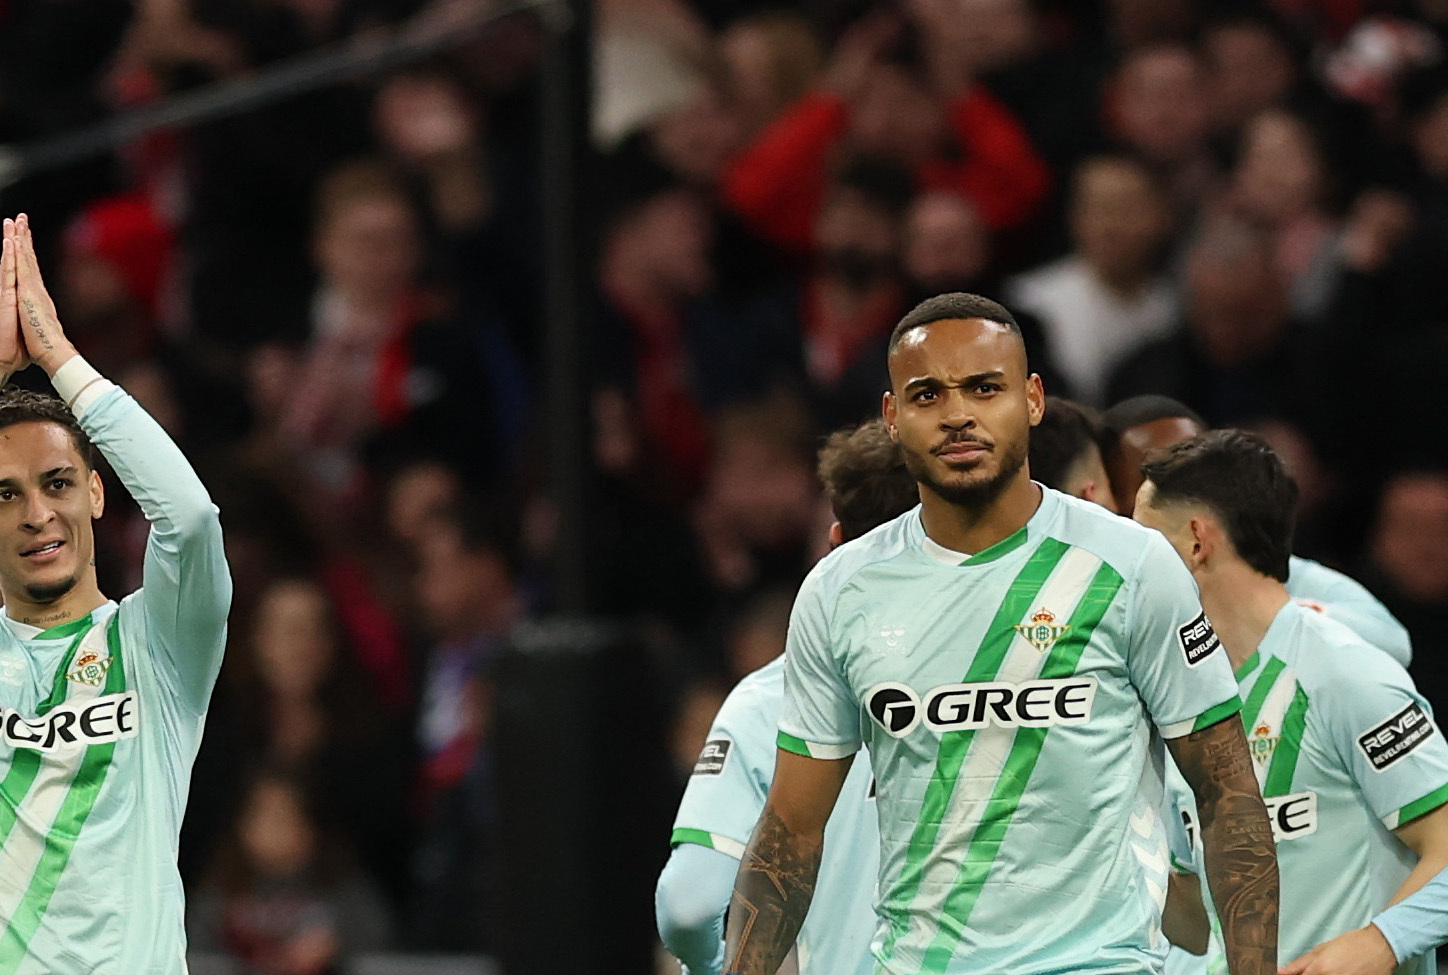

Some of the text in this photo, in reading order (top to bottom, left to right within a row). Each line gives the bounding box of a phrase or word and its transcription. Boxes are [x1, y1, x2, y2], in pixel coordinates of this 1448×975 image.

[6, 697, 133, 748] GREE
[927, 683, 1091, 725] GREE
[1363, 709, 1424, 754] REVEL
